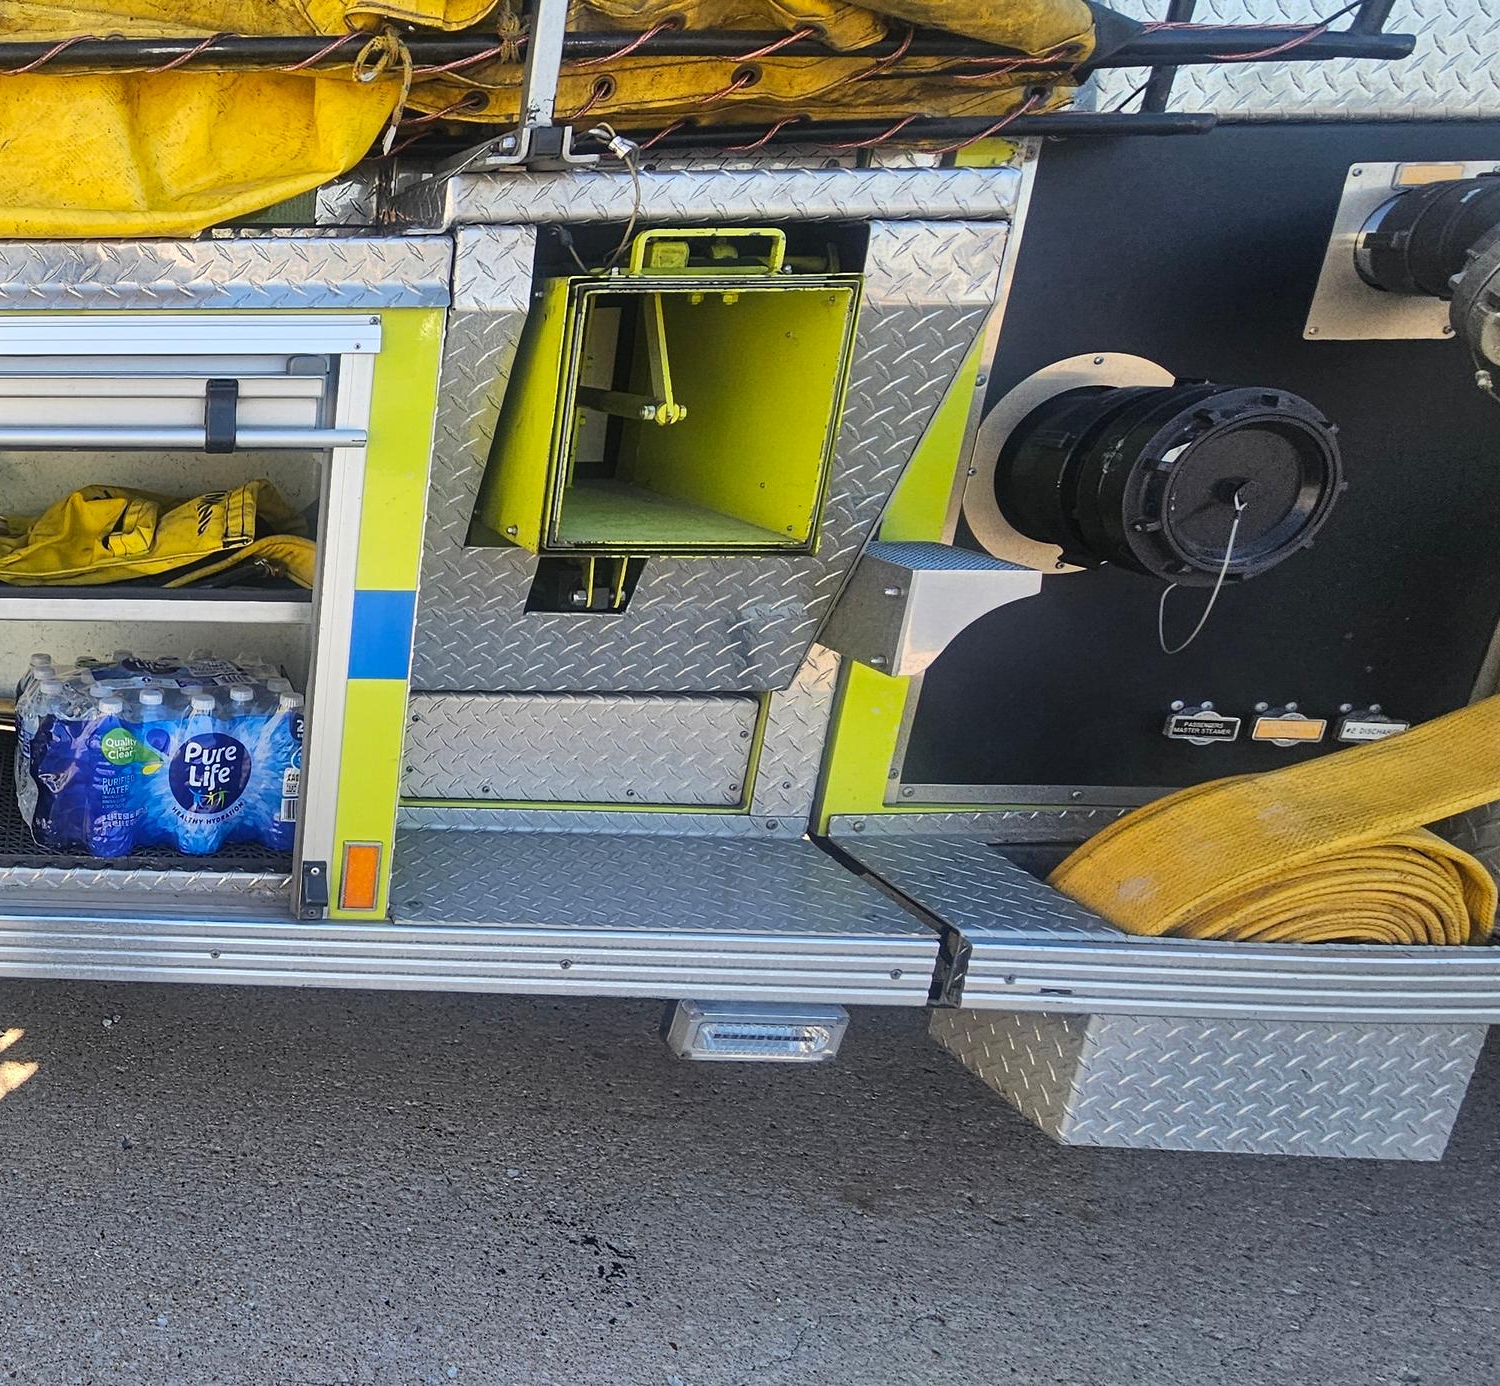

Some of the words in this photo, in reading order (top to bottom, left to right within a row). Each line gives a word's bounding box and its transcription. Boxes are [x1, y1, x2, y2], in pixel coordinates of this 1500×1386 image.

[105, 737, 137, 749] Quality
[108, 749, 133, 759] Clear
[184, 741, 237, 765] Pure
[102, 774, 135, 787] PURIFIED
[189, 763, 231, 791] Life
[102, 784, 130, 795] WATER
[171, 806, 204, 824] HEALTHY
[206, 801, 244, 824] HYDRATION
